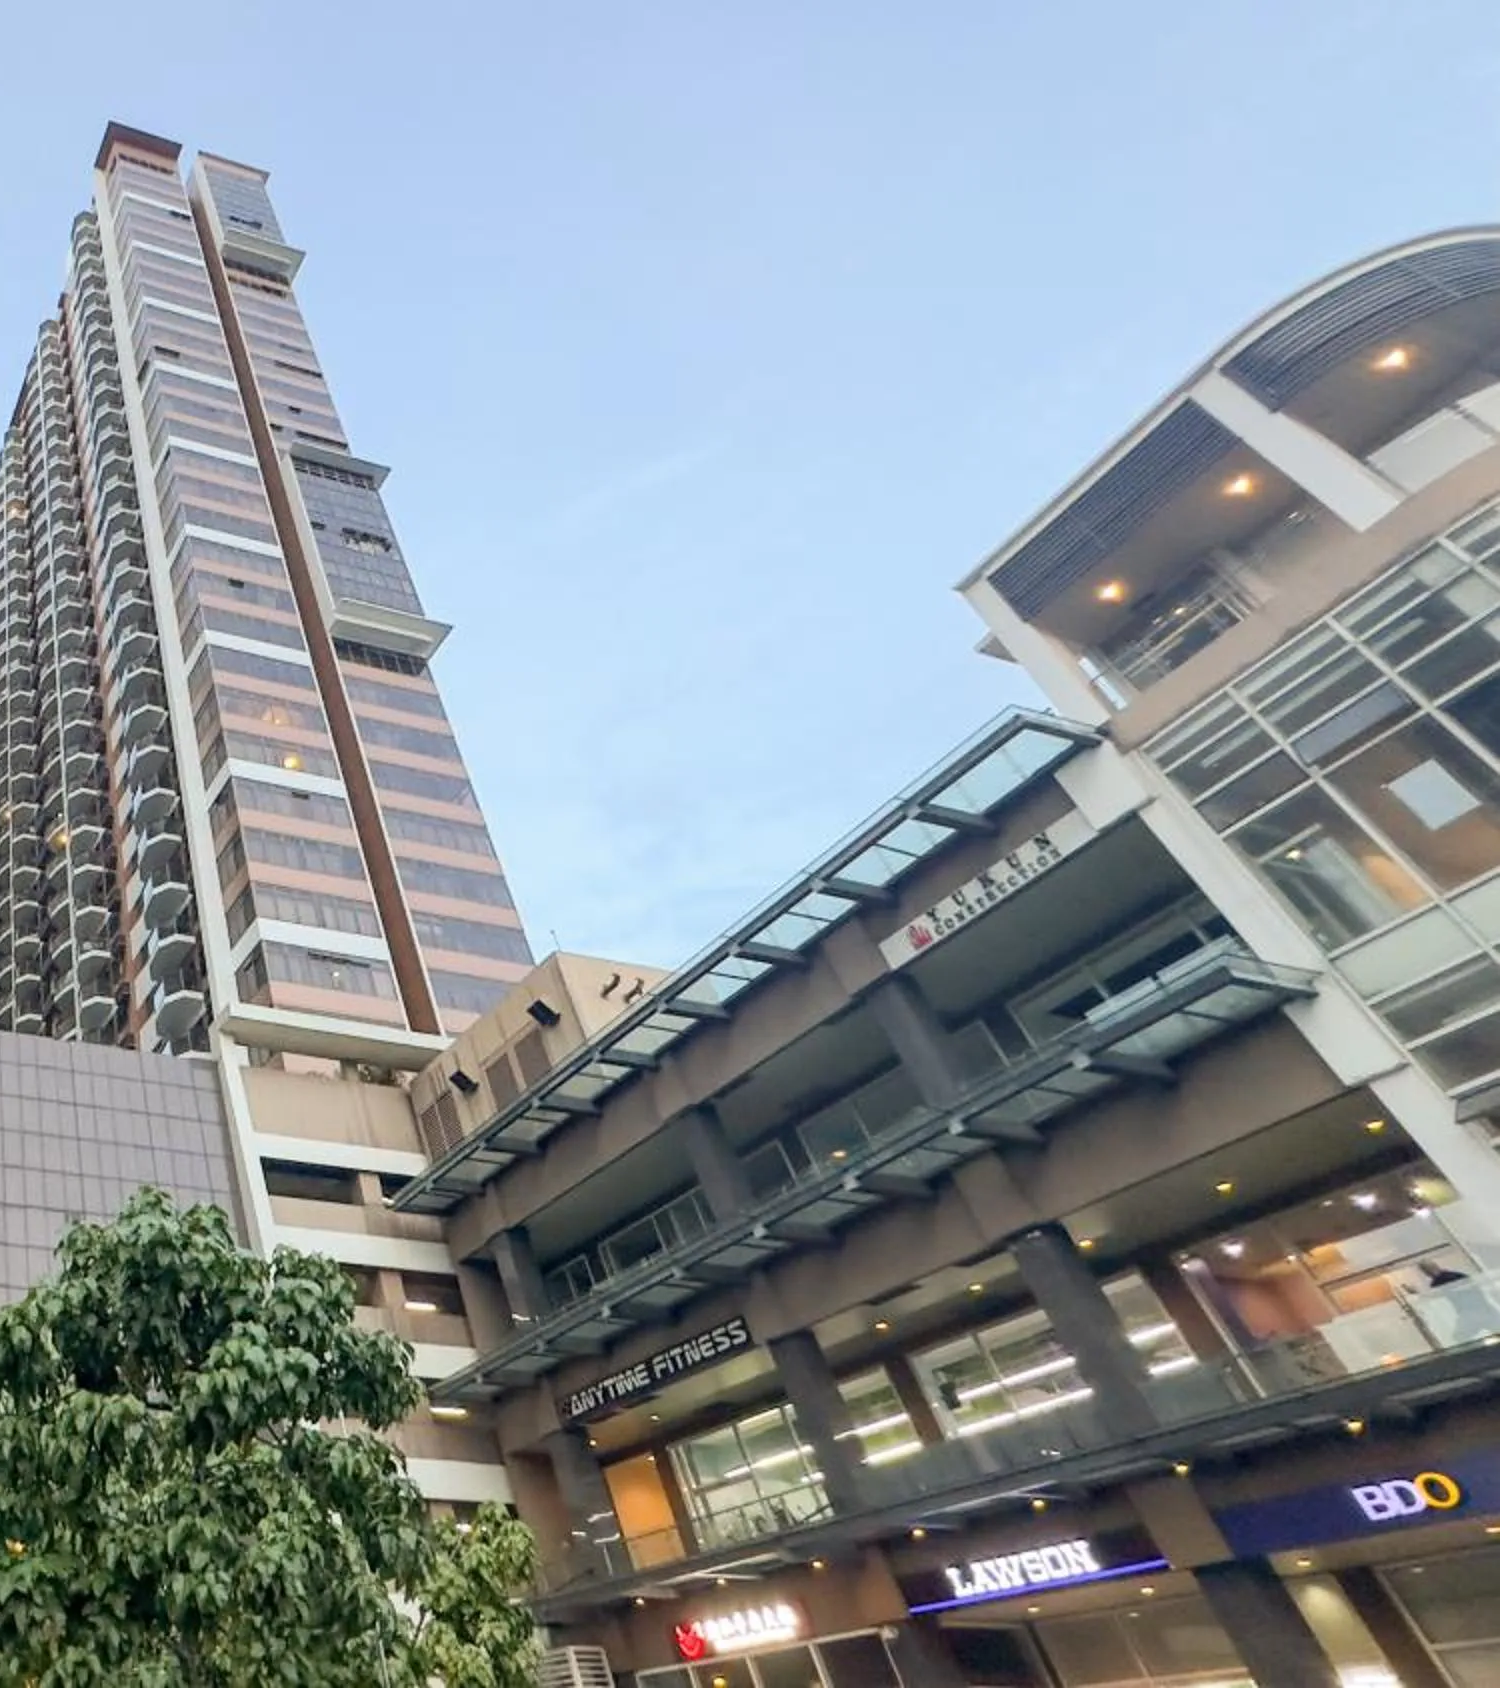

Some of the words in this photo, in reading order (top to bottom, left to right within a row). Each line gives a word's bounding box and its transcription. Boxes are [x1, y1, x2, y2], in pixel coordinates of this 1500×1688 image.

[927, 831, 1051, 922] YUKUN
[570, 1364, 651, 1416] ANYTIME
[652, 1319, 747, 1379] FITNESS
[1352, 1472, 1461, 1521] BDO
[945, 1538, 1100, 1597] LAWSON
